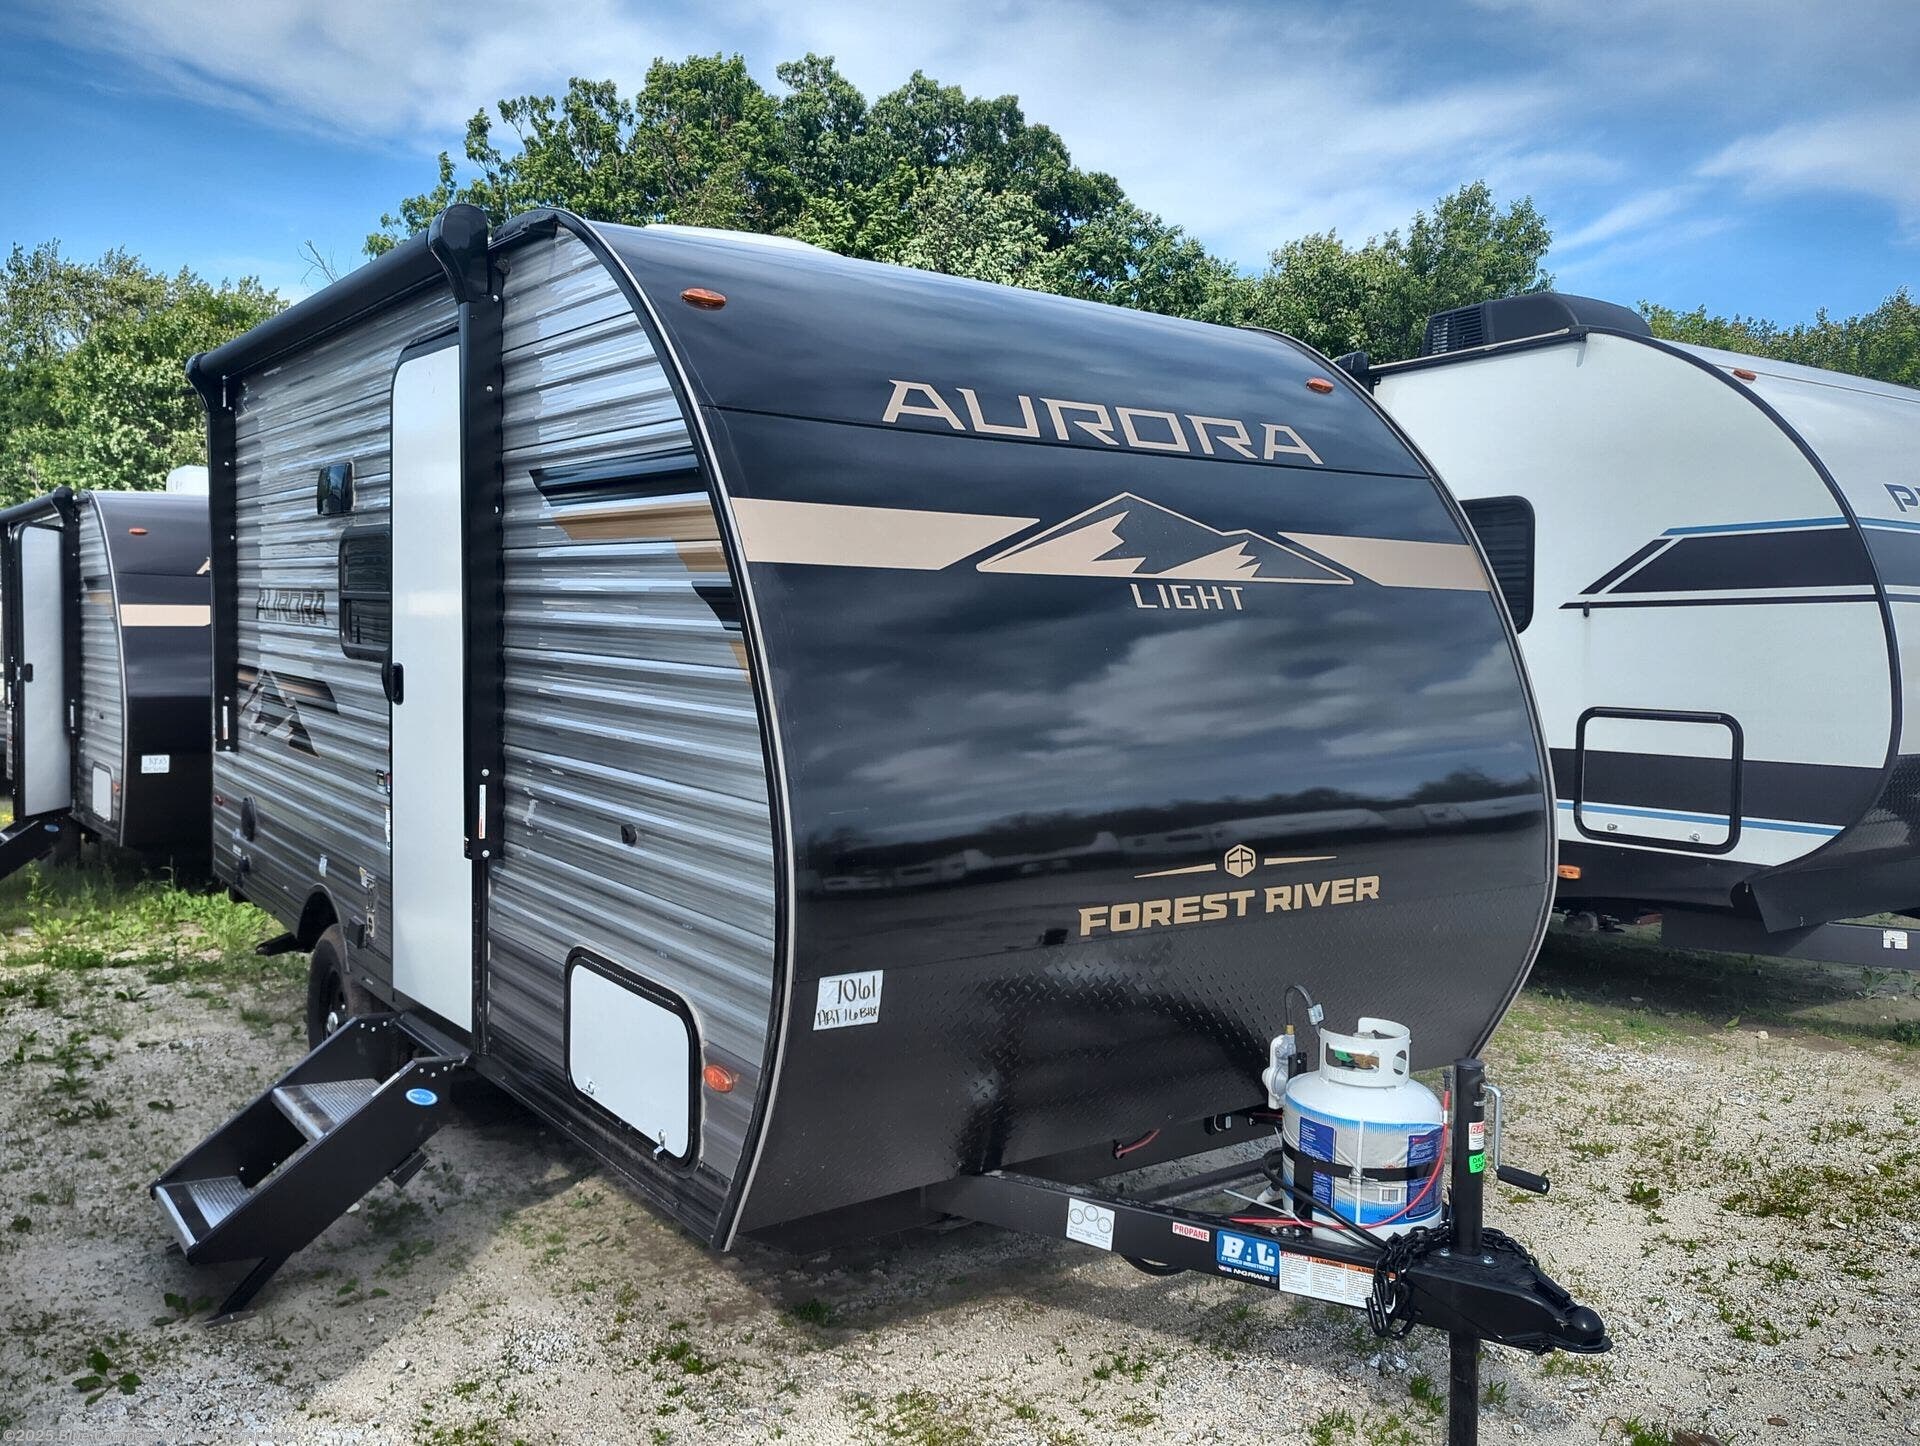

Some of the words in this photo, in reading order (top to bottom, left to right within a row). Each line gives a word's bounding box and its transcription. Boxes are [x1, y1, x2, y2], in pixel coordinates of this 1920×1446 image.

[881, 378, 1325, 466] AURORA
[255, 588, 327, 626] AURORA
[1130, 582, 1244, 611] LIGHT
[1078, 889, 1256, 936] FOREST
[1263, 875, 1381, 913] RIVER
[828, 975, 876, 1005] 7061
[1174, 1224, 1208, 1241] PROPANE
[1222, 1235, 1275, 1267] BAL
